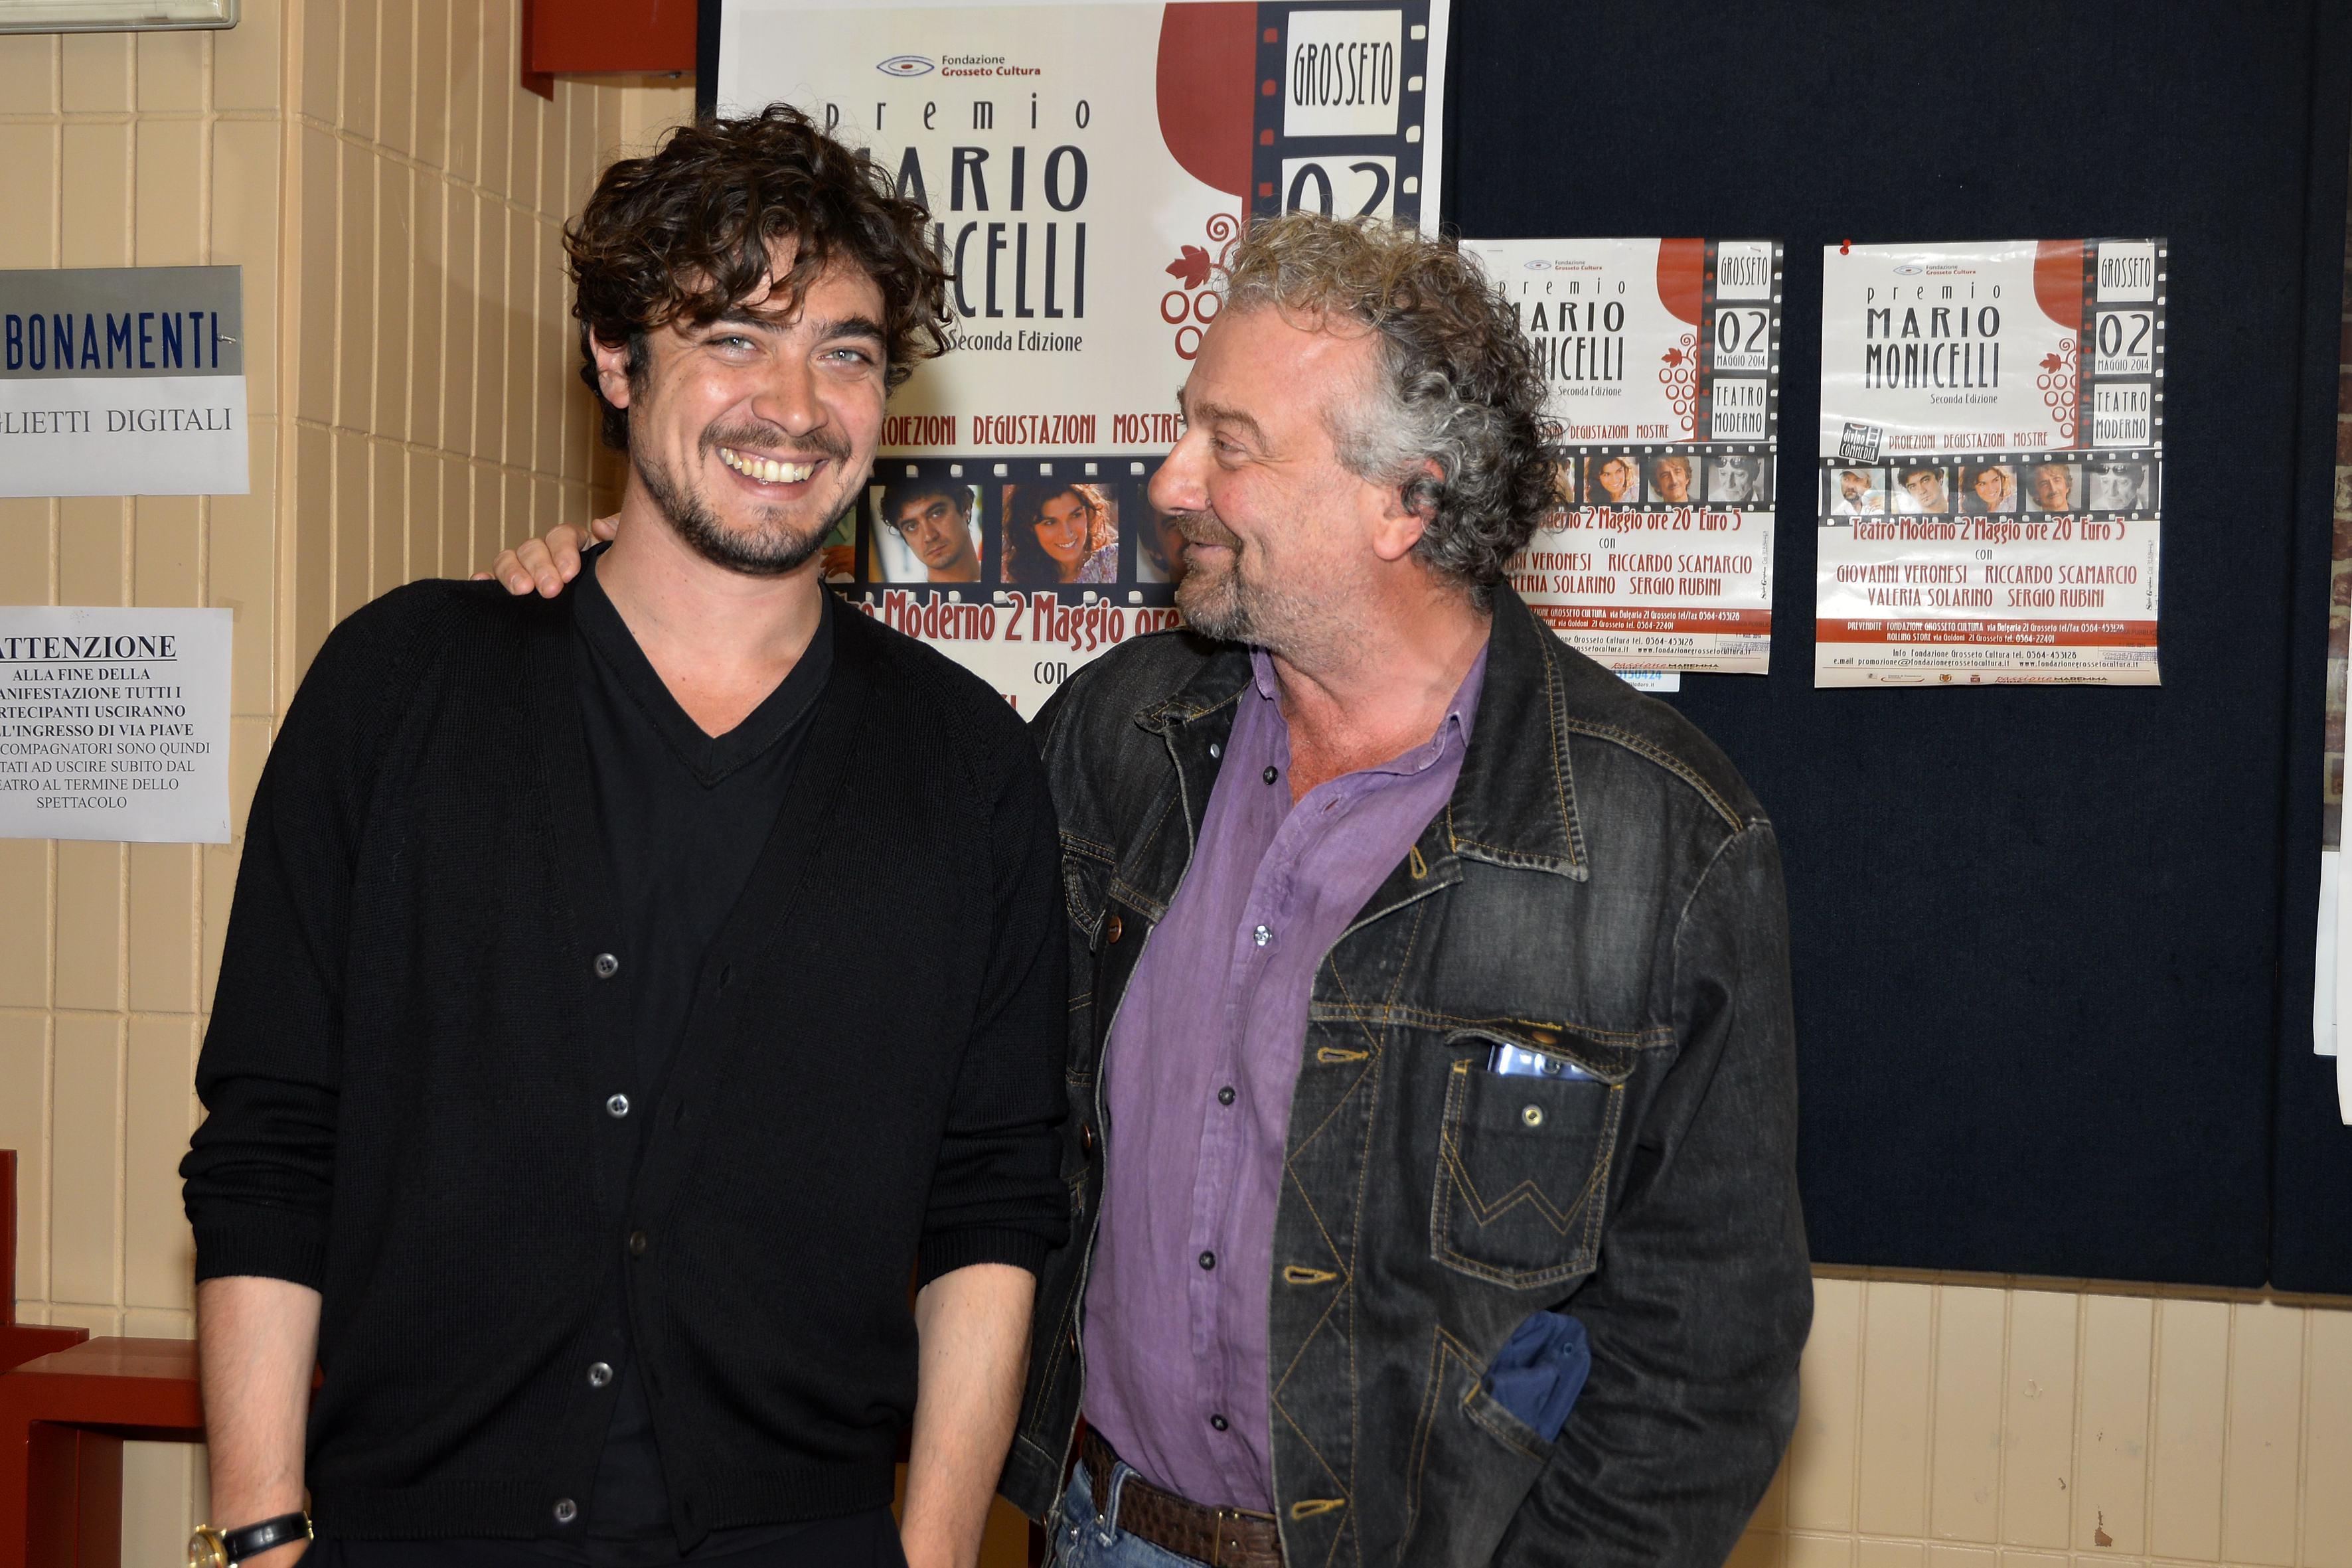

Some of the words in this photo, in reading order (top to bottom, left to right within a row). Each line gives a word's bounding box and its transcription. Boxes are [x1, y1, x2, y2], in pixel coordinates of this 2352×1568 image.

[941, 54, 1006, 65] Fondazione
[941, 66, 992, 77] Grosseto
[996, 66, 1041, 77] Cultura
[1293, 40, 1394, 108] GROSSETO
[854, 145, 1089, 213] ARIO
[931, 221, 1086, 319] ICELLI
[1721, 256, 1768, 286] GROSSETO
[2101, 257, 2151, 288] GROSSETO
[1867, 281, 2001, 304] premio
[1867, 306, 2000, 339] MARIO
[5, 311, 218, 370] BONAMENTI
[947, 331, 1013, 354] Seconda
[1018, 330, 1083, 353] Edizione
[1717, 311, 1767, 354] 02
[2098, 313, 2152, 357] 02
[1534, 336, 1624, 381] NICELLI
[1716, 355, 1746, 366] MAGGIO
[1748, 354, 1765, 366] 2014
[1865, 342, 1999, 389] MONICELLI
[2098, 360, 2128, 371] MAGGIO
[2131, 358, 2150, 370] 2014
[1558, 386, 1589, 395] Seconda
[1591, 386, 1622, 396] Edizione
[1715, 386, 1763, 406] TEATRO
[1930, 393, 1963, 404] Seconda
[1965, 394, 1998, 404] Edizione
[2098, 391, 2147, 412] TEATRO
[0, 410, 90, 434] LIETTI
[106, 408, 233, 432] DIGITALI
[973, 414, 1096, 445] DEGUSTAZIONI
[1113, 413, 1184, 443] MOSTRE
[1715, 412, 1762, 433] MODERNO
[2096, 418, 2146, 439] MODERNO
[1571, 424, 1629, 439] DEGUSTAZIONI
[1637, 424, 1669, 438] MOSTRE
[1843, 430, 1865, 444] divino
[1889, 435, 1936, 449] PROIEZIONI
[1944, 432, 2005, 448] DEGUSTAZIONI
[2014, 431, 2048, 446] MOSTRE
[1841, 443, 1875, 461] COMMEDIA
[1585, 507, 1595, 529] 2
[1599, 508, 1642, 532] Maggio
[1648, 512, 1668, 529] ore
[1673, 509, 1691, 530] 20
[1699, 509, 1726, 531] Euro
[1732, 509, 1741, 530] 5
[1853, 518, 1896, 540] Teatro
[1900, 518, 1956, 541] Moderno
[1961, 518, 1970, 540] 2
[1975, 518, 2021, 544] Maggio
[2026, 522, 2047, 541] ore
[2052, 518, 2072, 540] 20
[2081, 518, 2110, 541] Euro
[2116, 518, 2125, 540] 5
[1599, 538, 1615, 548] con
[1531, 553, 1591, 570] VERONESI
[1608, 554, 1673, 572] RICCARDO
[1678, 555, 1752, 574] SCAMARCIO
[1976, 549, 1993, 560] con
[1837, 565, 1899, 583] GIOVANNI
[1905, 565, 1967, 584] VERONESI
[1986, 565, 2053, 584] RICCARDO
[2059, 565, 2137, 585] SCAMARCIO
[1553, 576, 1615, 594] SOLARINO
[1629, 577, 1674, 595] SERGIO
[1679, 578, 1721, 596] RUBINI
[1867, 588, 1921, 607] VALERIA
[1928, 588, 1993, 607] SOLARINO
[2007, 589, 2057, 607] SERGIO
[2060, 589, 2104, 607] RUBINI
[884, 590, 996, 641] Moderno
[1005, 593, 1024, 641] 2
[1032, 593, 1125, 652] Maggio
[1135, 609, 1180, 636] ore
[1551, 609, 1580, 617] GROSSETO
[1582, 609, 1606, 618] CULTURA
[1620, 610, 1642, 619] Bulgaria
[1678, 611, 1697, 620] tel/fax
[1699, 612, 1740, 621] 0564-453128
[1599, 620, 1624, 629] Grosseto
[1636, 621, 1674, 631] 0564-22491
[1847, 621, 1881, 630] PREVENDITE
[1887, 622, 1922, 631] FONDAZIONE
[1924, 623, 1956, 631] GROSSETO
[1958, 623, 1983, 631] CULTURA
[1998, 623, 2021, 633] Bulgaria
[2059, 623, 2079, 632] tel/fax
[1645, 637, 1693, 646] 0564-453128
[1976, 634, 2003, 643] Grosseto
[1951, 649, 1982, 658] Grosseto
[13, 669, 54, 681] ALLA
[58, 668, 93, 680] FINE
[99, 668, 151, 680] DELLA
[1034, 662, 1067, 684] con
[125, 686, 172, 699] TUTTI
[175, 686, 181, 698] I
[95, 705, 186, 718] USCIRANNO
[0, 725, 94, 738] L'INGRESSO
[99, 724, 114, 736] DI
[119, 724, 145, 736] VIA
[150, 724, 194, 736] PIAVE
[1, 743, 112, 755] COMPAGNATORI
[118, 743, 155, 755] SONO
[159, 742, 210, 756] QUINDI
[32, 761, 51, 773] AD
[56, 761, 106, 773] USCIRE
[112, 761, 162, 772] SUBITO
[167, 760, 195, 772] DAL
[42, 779, 60, 791] AL
[64, 779, 128, 790] TERMINE
[133, 778, 179, 790] DELLO
[37, 797, 127, 809] SPETTACOLO
